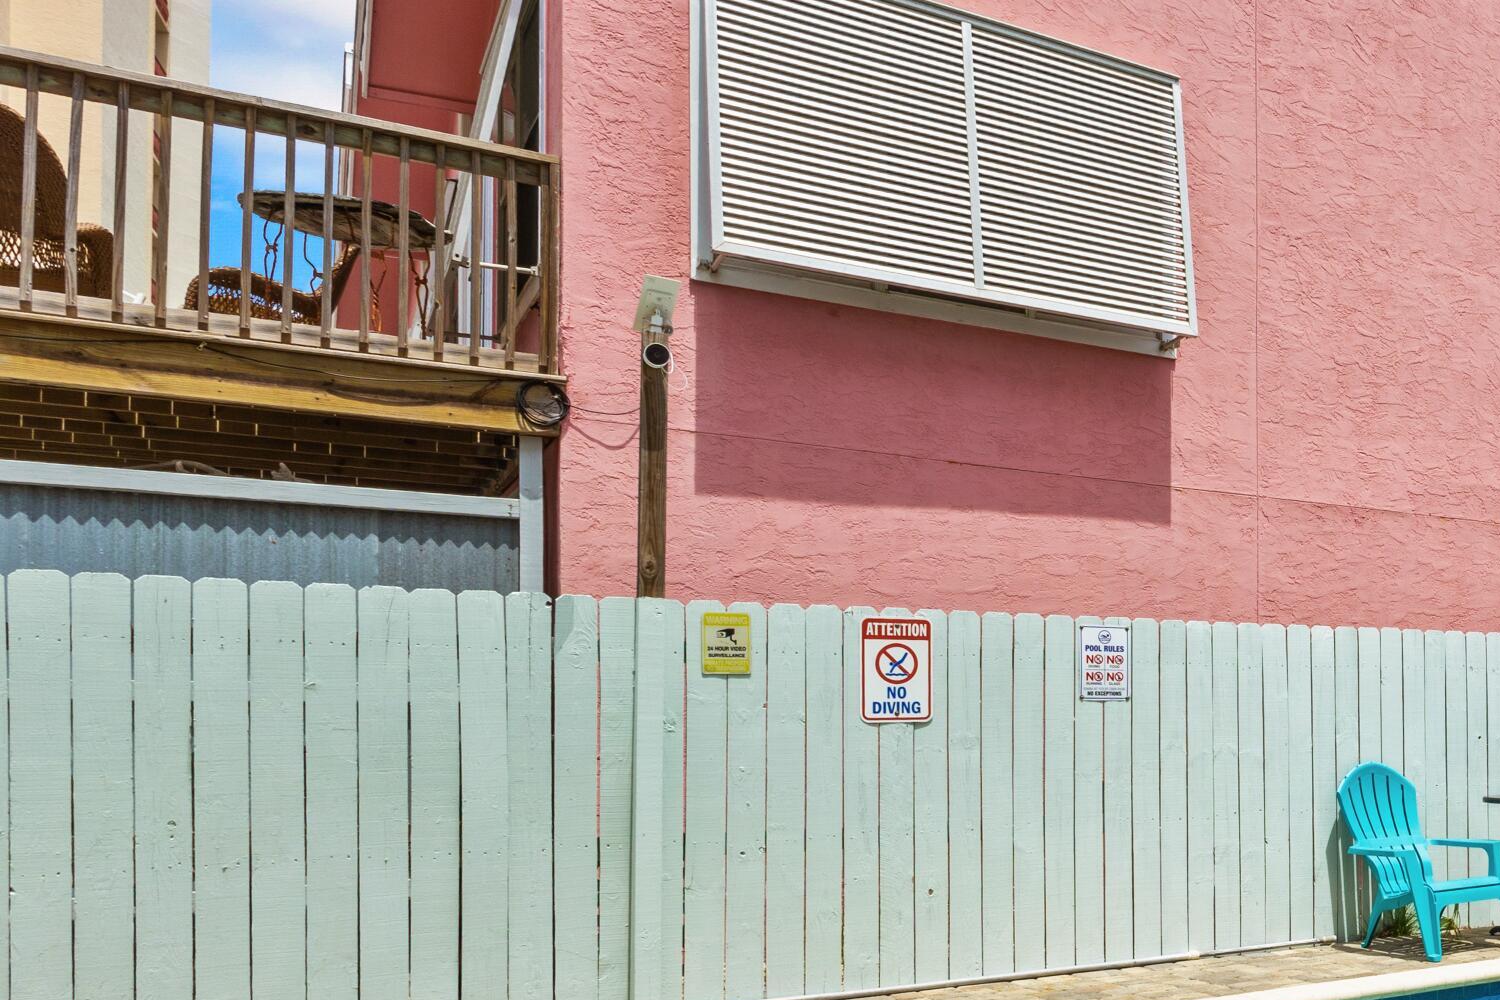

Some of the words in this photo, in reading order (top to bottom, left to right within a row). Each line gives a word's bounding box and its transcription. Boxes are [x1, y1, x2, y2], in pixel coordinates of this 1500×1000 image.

[705, 616, 747, 625] WARNING
[866, 622, 927, 636] ATTENTION
[887, 686, 907, 699] NO
[872, 701, 921, 714] DIVING
